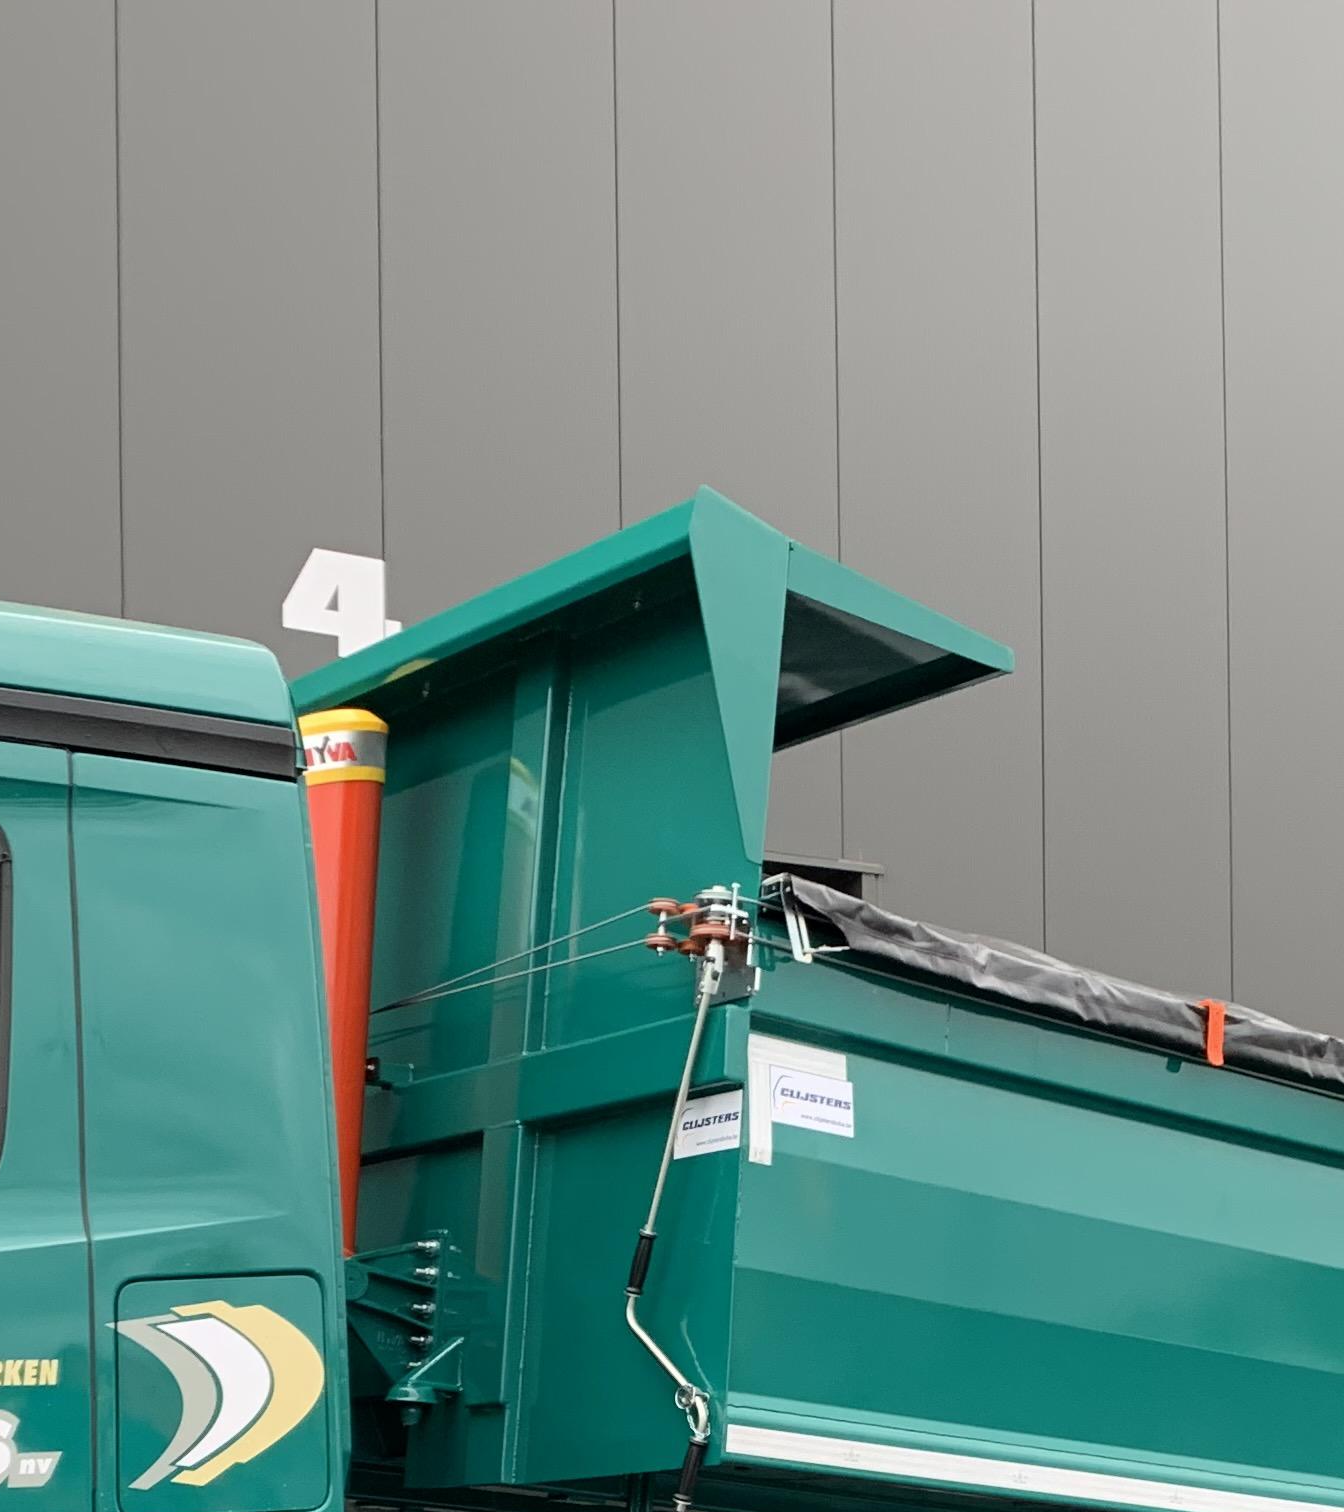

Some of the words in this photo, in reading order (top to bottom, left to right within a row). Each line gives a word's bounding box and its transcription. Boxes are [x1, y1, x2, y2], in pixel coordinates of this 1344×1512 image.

[282, 547, 403, 658] 4
[780, 1087, 852, 1111] CLIJSTERS
[682, 1111, 740, 1131] CLIJSTERS
